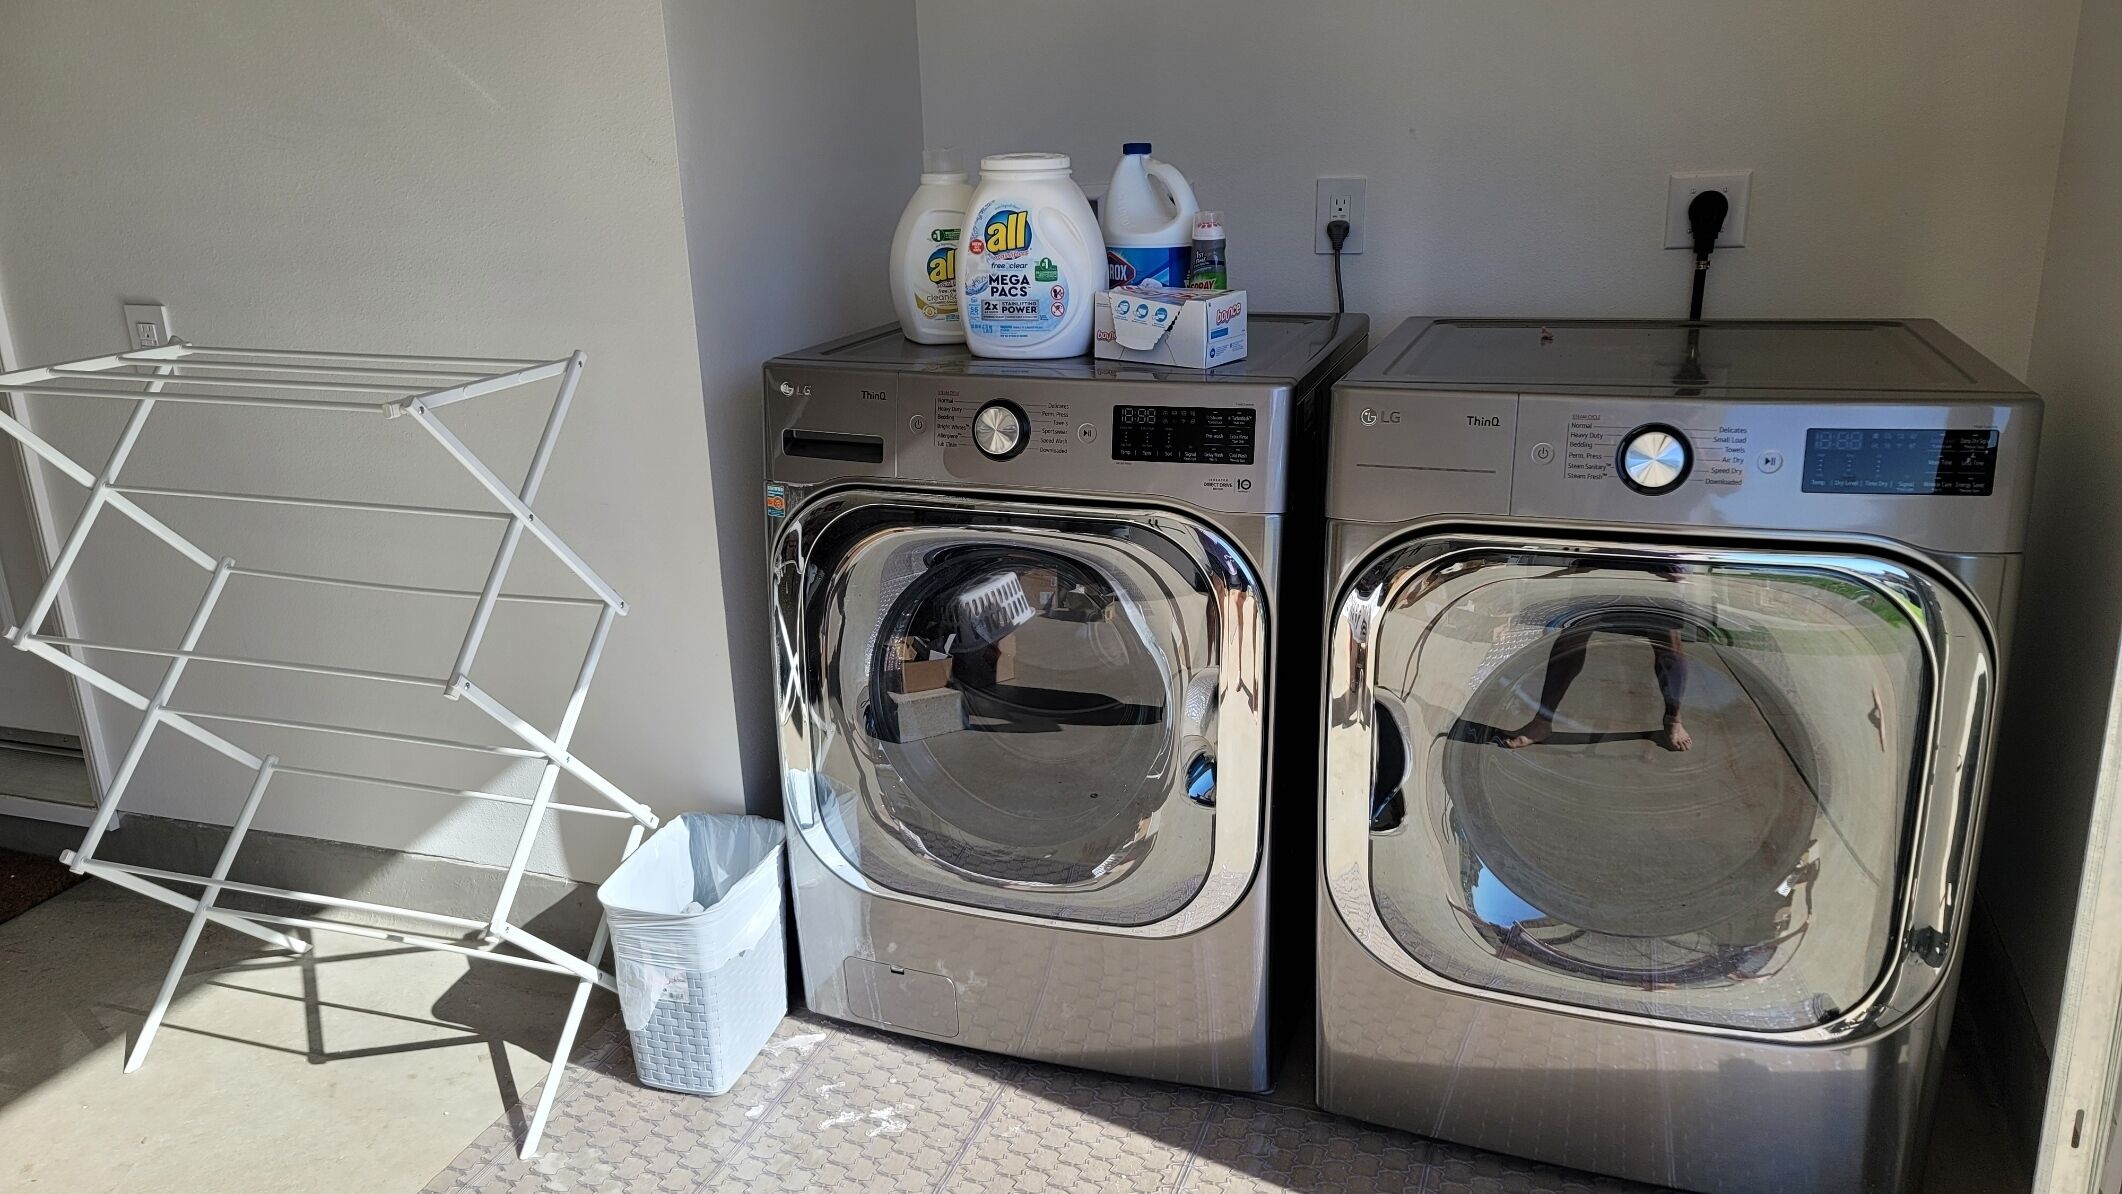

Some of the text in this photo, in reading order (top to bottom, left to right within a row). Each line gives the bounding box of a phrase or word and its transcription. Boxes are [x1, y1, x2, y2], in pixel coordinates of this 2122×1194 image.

[986, 211, 1028, 254] all
[929, 248, 957, 284] al
[1109, 264, 1127, 281] ROX
[989, 274, 1031, 285] MEGA
[984, 301, 998, 311] 2x
[1002, 306, 1037, 314] POWER
[1216, 302, 1241, 325] bounce
[1097, 330, 1117, 341] boun
[796, 384, 812, 396] LG
[861, 390, 887, 401] ThinQ
[1380, 410, 1401, 424] LG
[1466, 415, 1501, 427] ThinQ
[1719, 426, 1748, 434] Delicates
[1589, 432, 1604, 440] Duty
[1731, 436, 1747, 444] Load
[1569, 441, 1593, 449] Bedding
[1724, 446, 1746, 454] Towels
[1732, 456, 1744, 465] Dry
[1731, 467, 1743, 476] Dry
[1705, 478, 1743, 486] Downloaded
